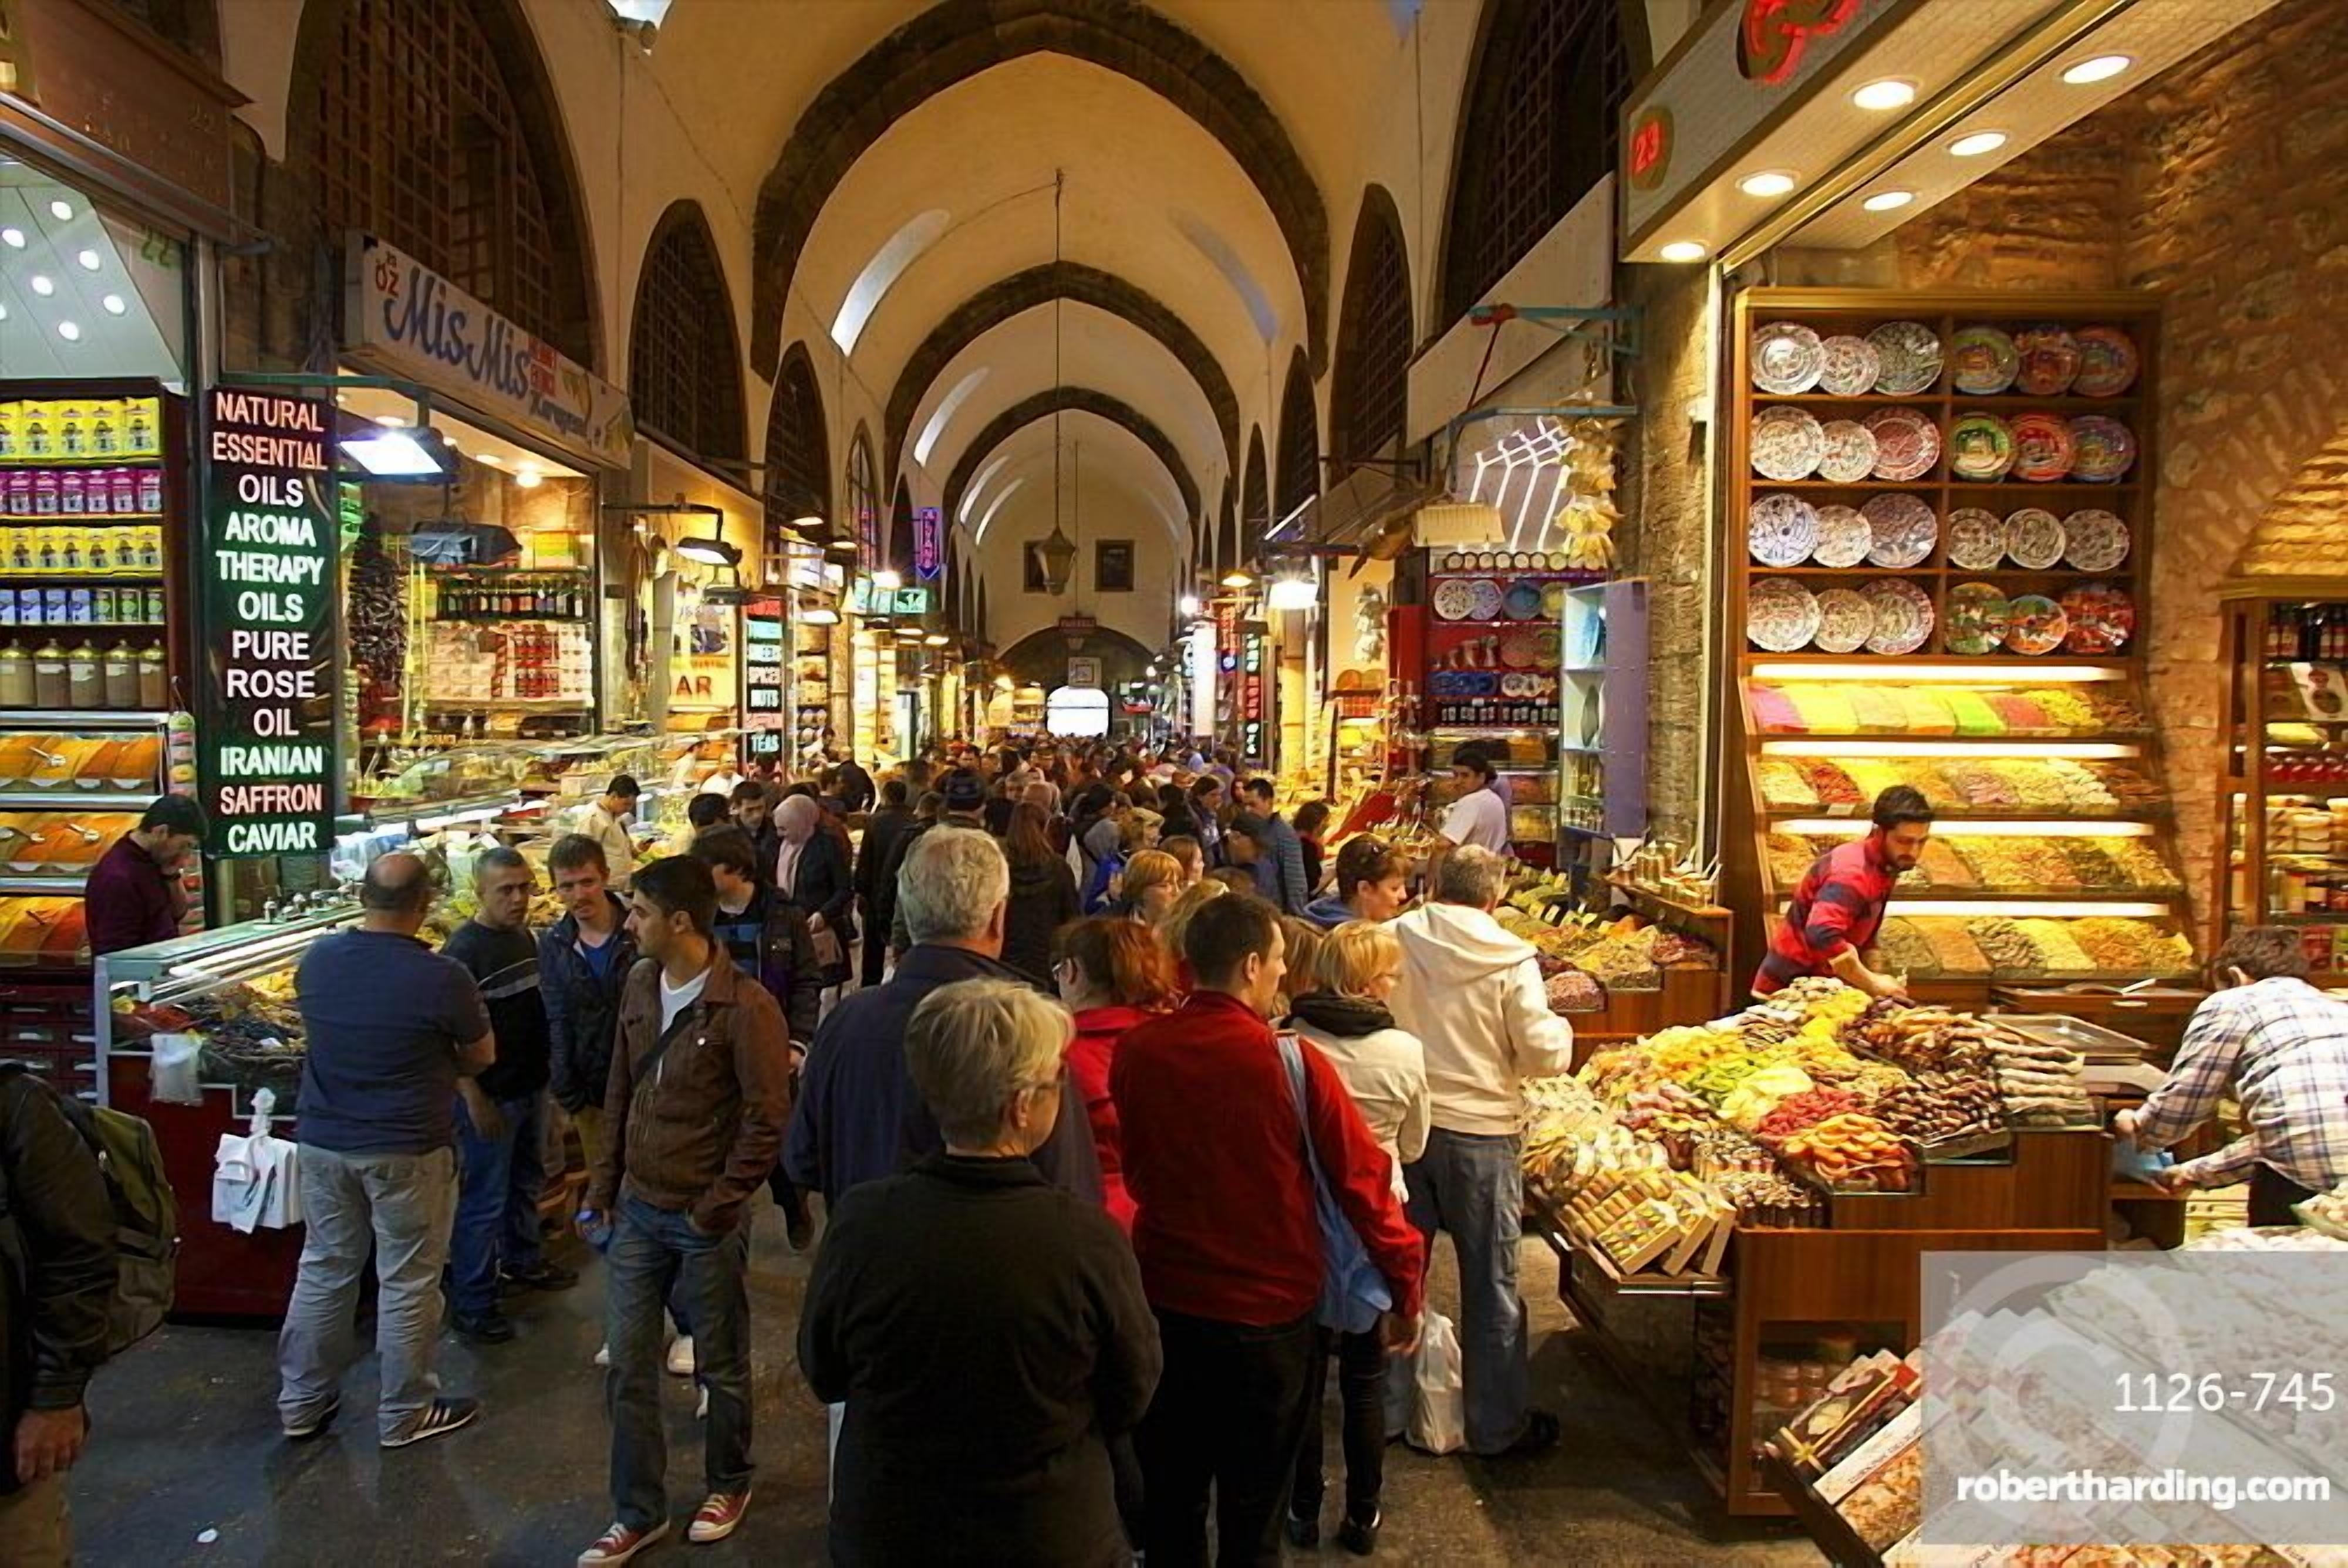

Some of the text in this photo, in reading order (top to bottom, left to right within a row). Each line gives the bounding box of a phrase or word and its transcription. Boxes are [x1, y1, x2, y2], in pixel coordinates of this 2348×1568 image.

[384, 266, 467, 364] Mis
[466, 314, 529, 400] Mis
[217, 392, 324, 432] NATURAL
[213, 432, 328, 469] ESSENTIAL
[238, 474, 304, 507] OILS
[225, 512, 316, 548] AROMA
[215, 550, 325, 585] THERAPY
[238, 591, 303, 622] OILS
[232, 631, 309, 661] PURE
[227, 670, 316, 698] ROSE
[254, 709, 299, 736] OIL
[220, 746, 322, 776] IRANIAN
[220, 784, 322, 815] SAFFRON
[228, 822, 316, 853] CAVIAR
